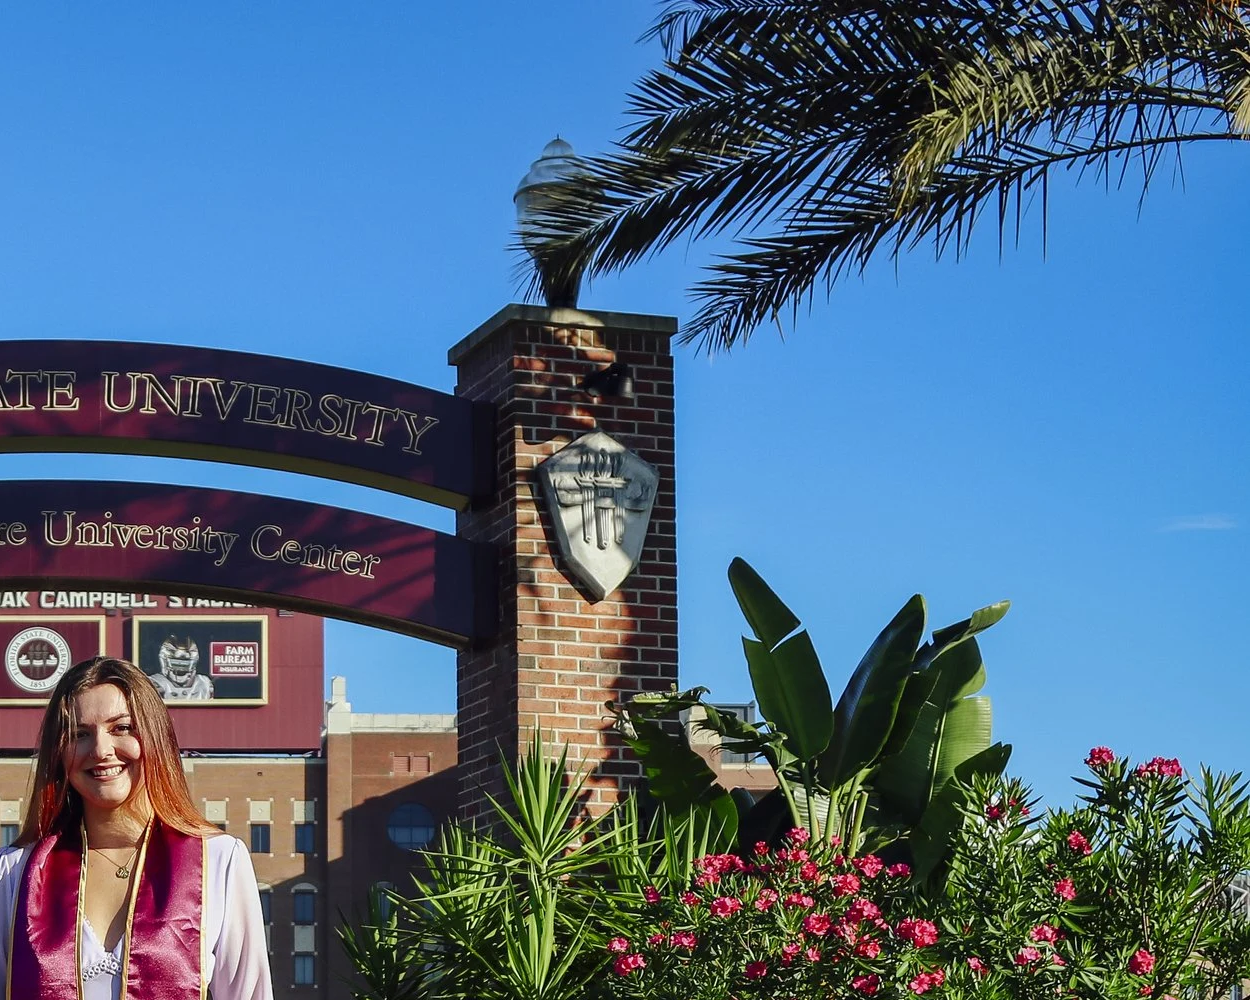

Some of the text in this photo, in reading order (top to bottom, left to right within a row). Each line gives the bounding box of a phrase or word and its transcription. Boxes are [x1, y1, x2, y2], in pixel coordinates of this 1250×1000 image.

[102, 371, 440, 456] UNIVERSITY
[41, 510, 239, 567] University
[250, 524, 381, 580] Center
[39, 591, 158, 608] CAMPBELL
[225, 645, 254, 655] FARM
[214, 655, 254, 664] BUREAU
